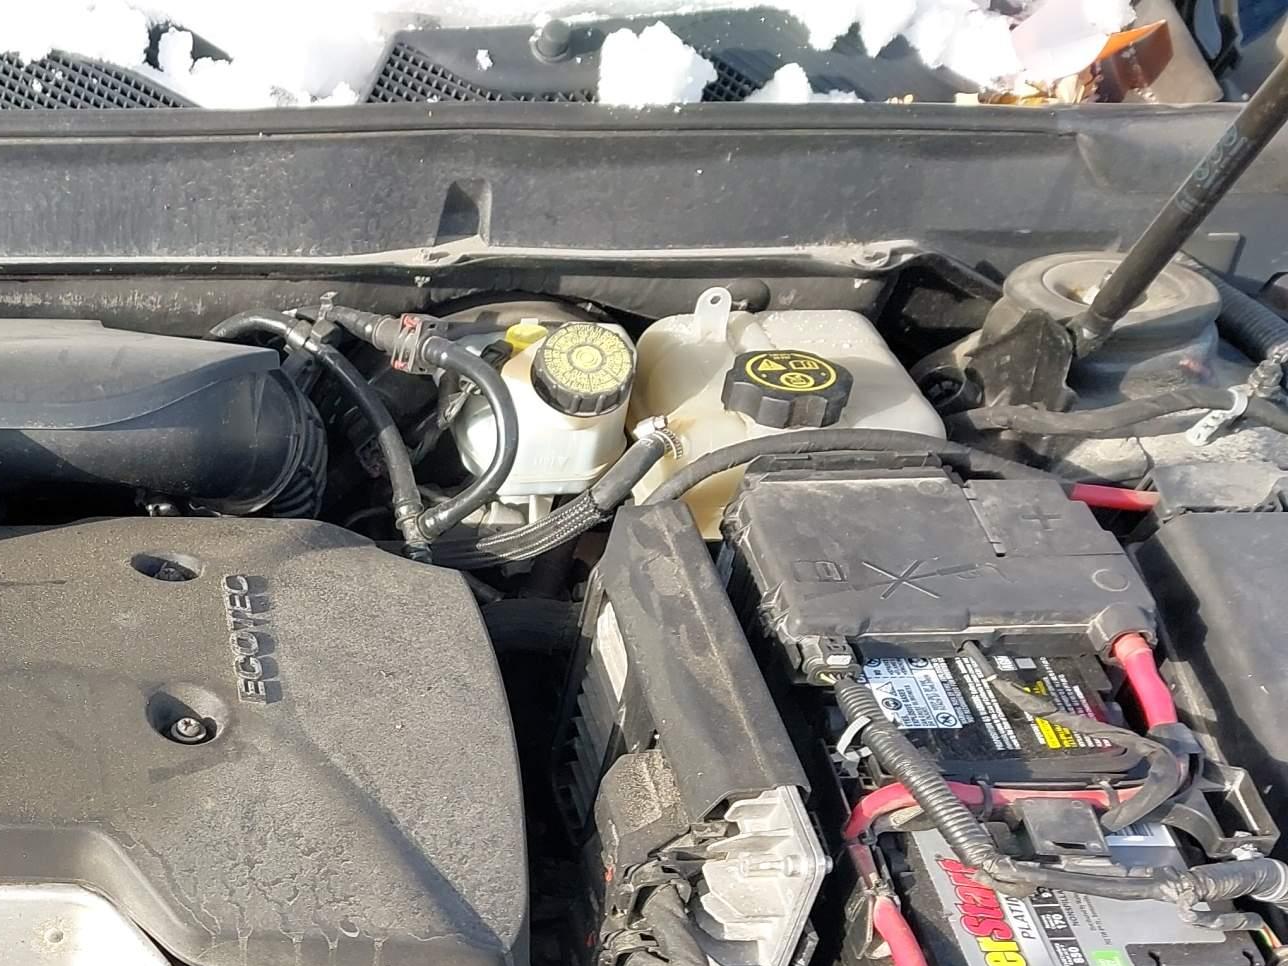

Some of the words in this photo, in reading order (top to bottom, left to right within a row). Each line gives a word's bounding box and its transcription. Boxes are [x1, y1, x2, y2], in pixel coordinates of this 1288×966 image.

[1005, 896, 1037, 940] PLATIN
[1051, 913, 1069, 931] 170
[1067, 946, 1086, 965] 850
